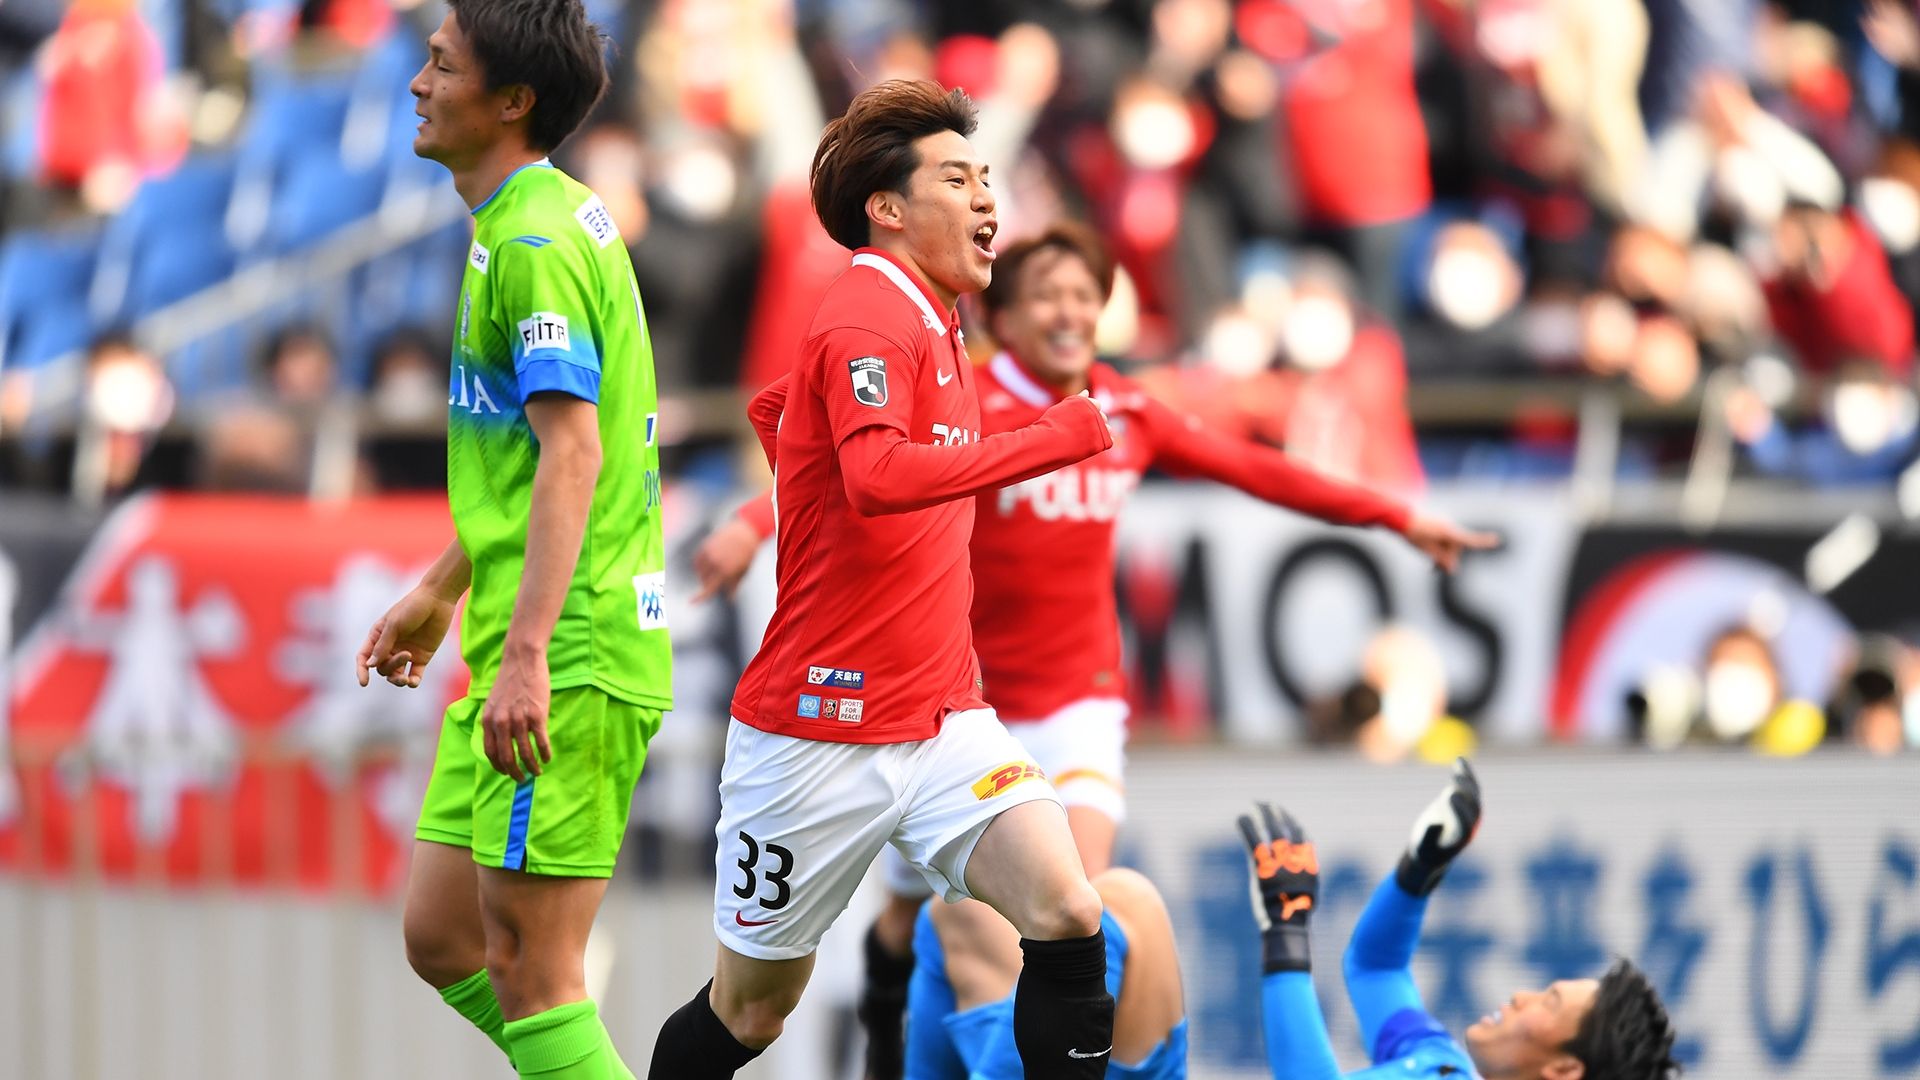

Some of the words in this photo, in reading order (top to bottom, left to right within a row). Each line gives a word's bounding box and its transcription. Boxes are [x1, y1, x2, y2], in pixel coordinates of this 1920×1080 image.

[834, 670, 862, 682] 天皇杯
[733, 830, 795, 911] 33
